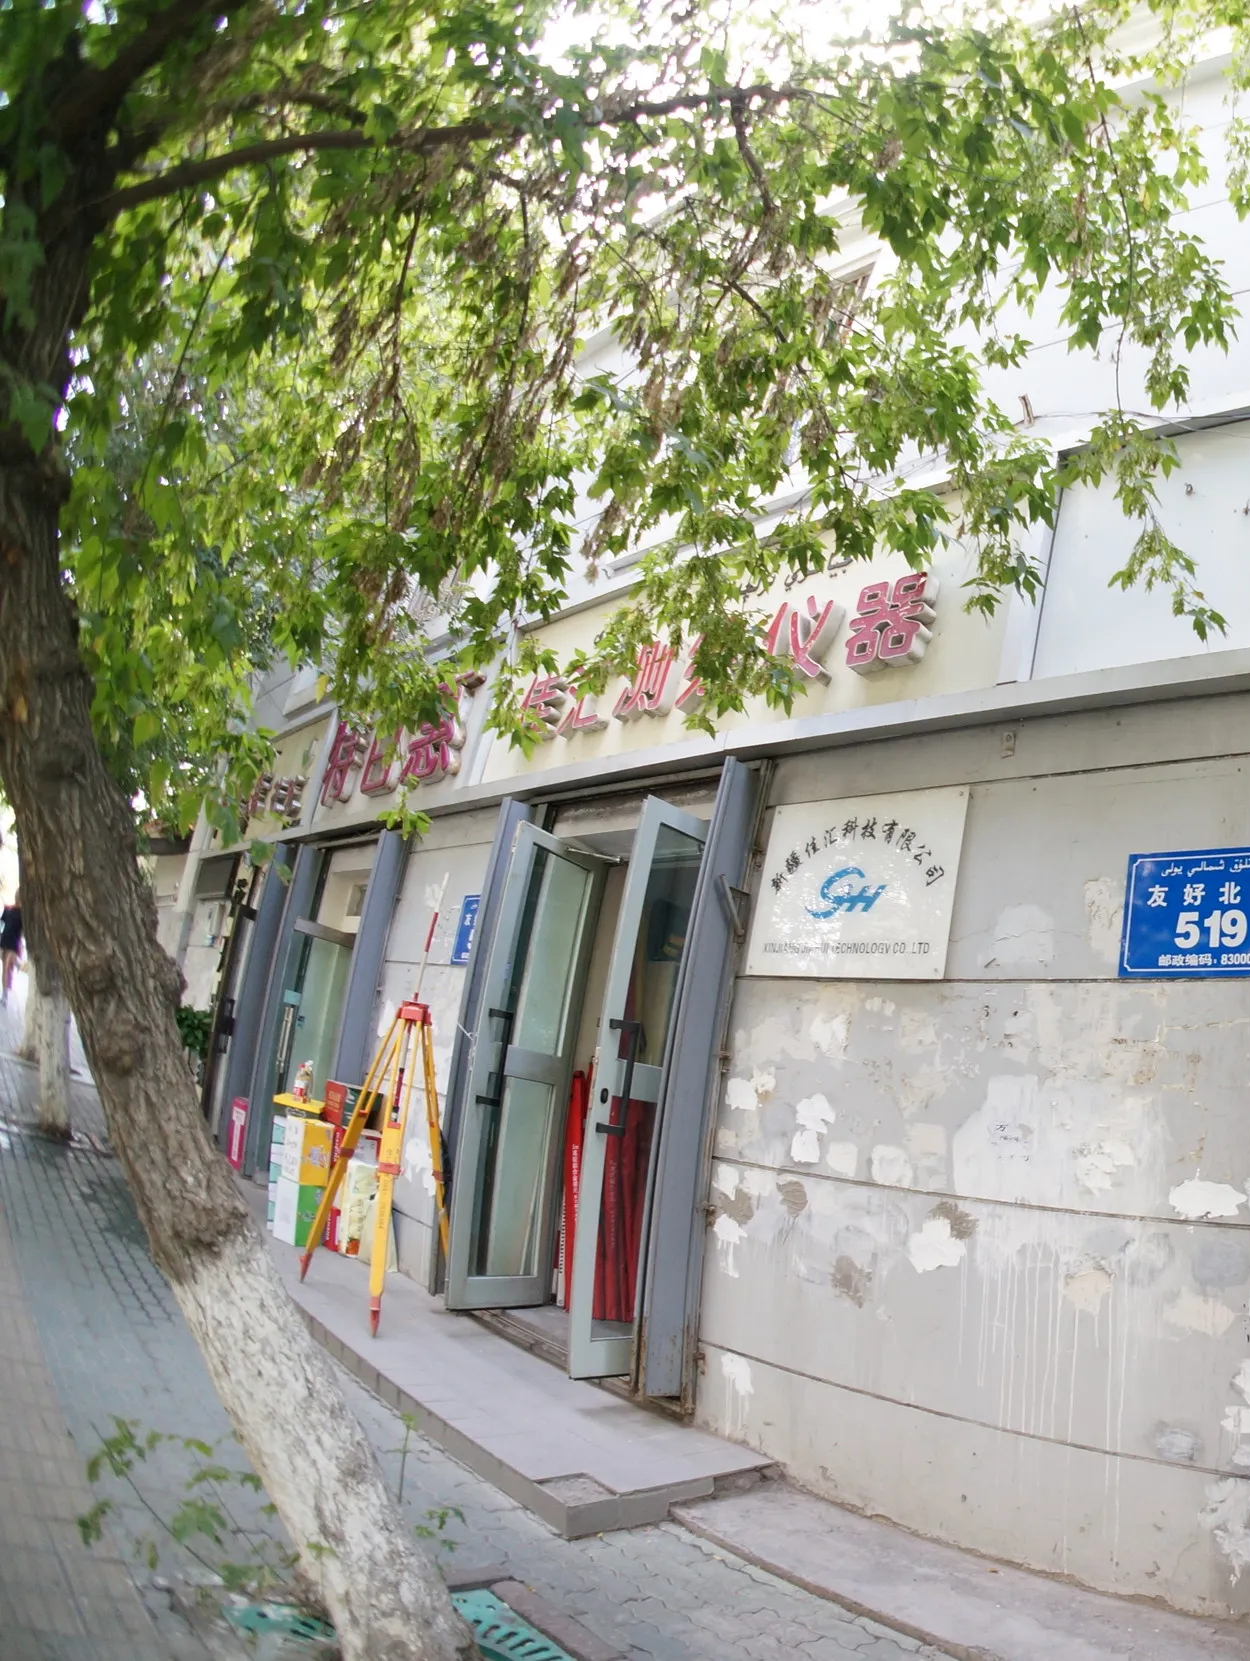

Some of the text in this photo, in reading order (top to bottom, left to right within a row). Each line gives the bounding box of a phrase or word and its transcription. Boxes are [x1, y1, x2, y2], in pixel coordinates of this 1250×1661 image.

[519, 571, 932, 736] 佳汇测仪器
[1174, 909, 1248, 949] 519
